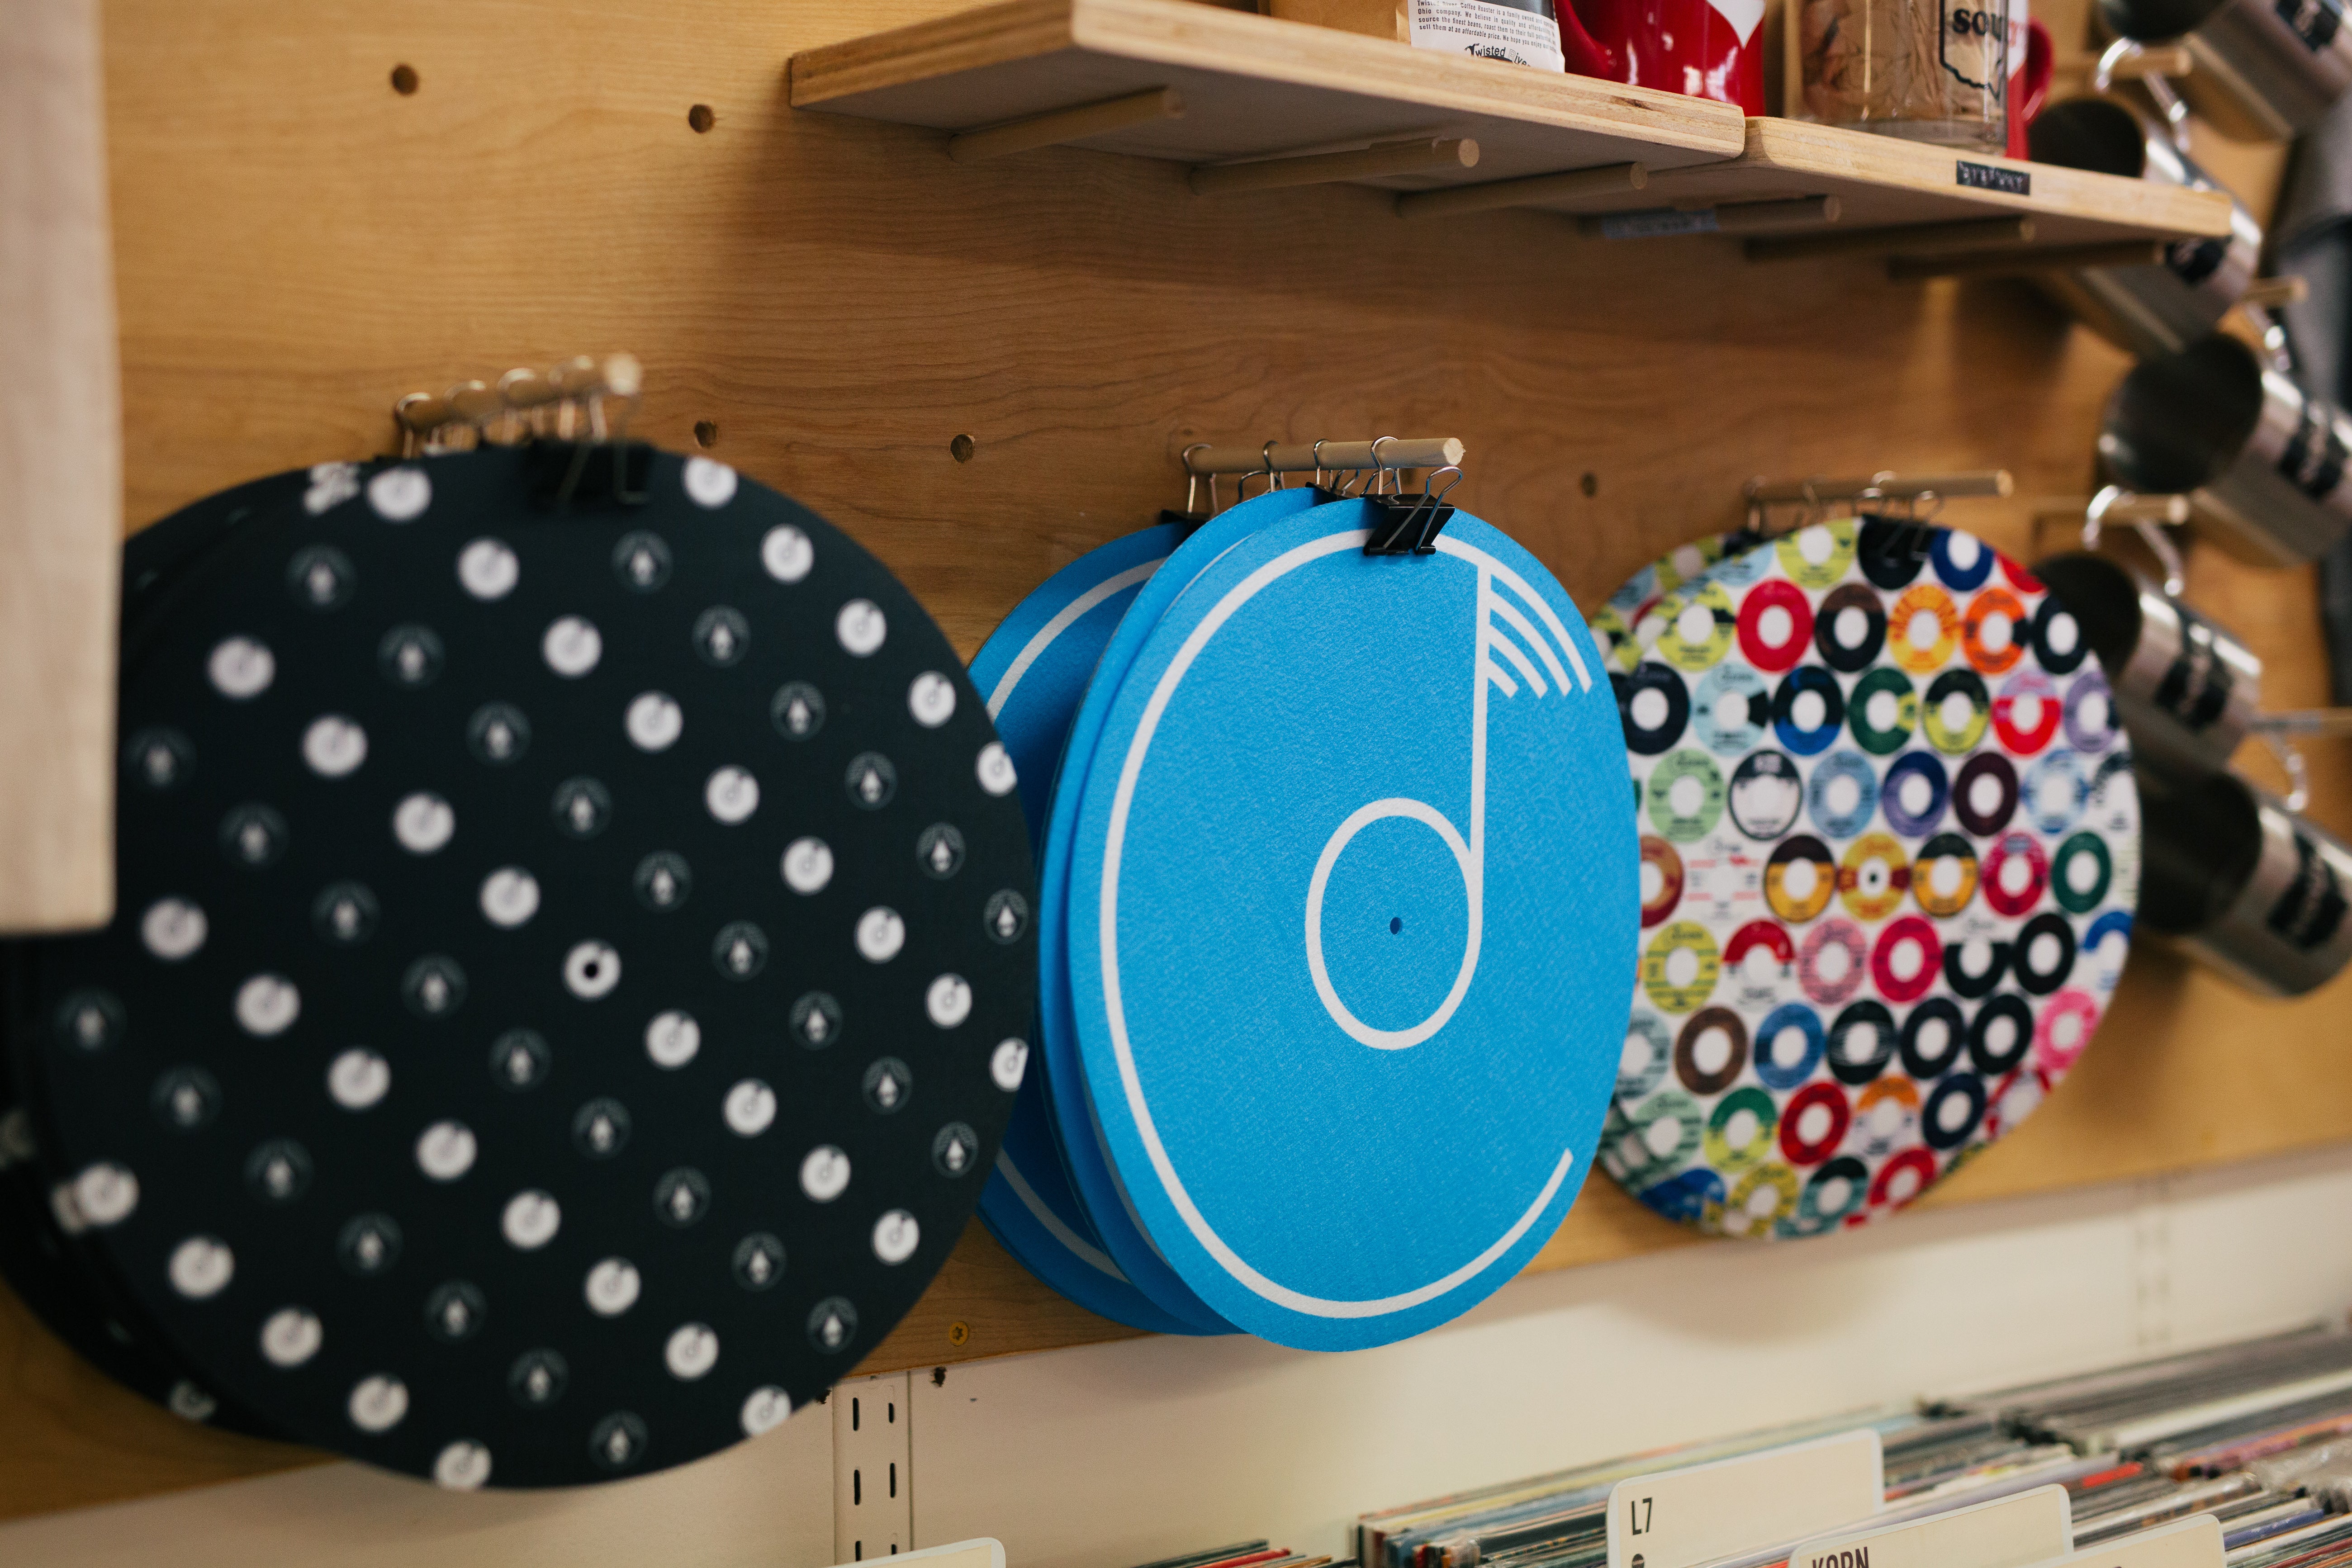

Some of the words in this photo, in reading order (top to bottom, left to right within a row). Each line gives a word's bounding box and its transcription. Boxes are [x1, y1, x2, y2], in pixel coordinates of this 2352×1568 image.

[1478, 5, 1494, 14] Roaster
[1507, 11, 1520, 19] family
[1468, 20, 1483, 28] beans,
[1475, 13, 1491, 21] believe
[1501, 19, 1516, 27] quality
[1462, 28, 1486, 37] affordable
[1464, 43, 1506, 57] Twisted
[1508, 48, 1531, 66] Rive
[1631, 1497, 1652, 1535] L7
